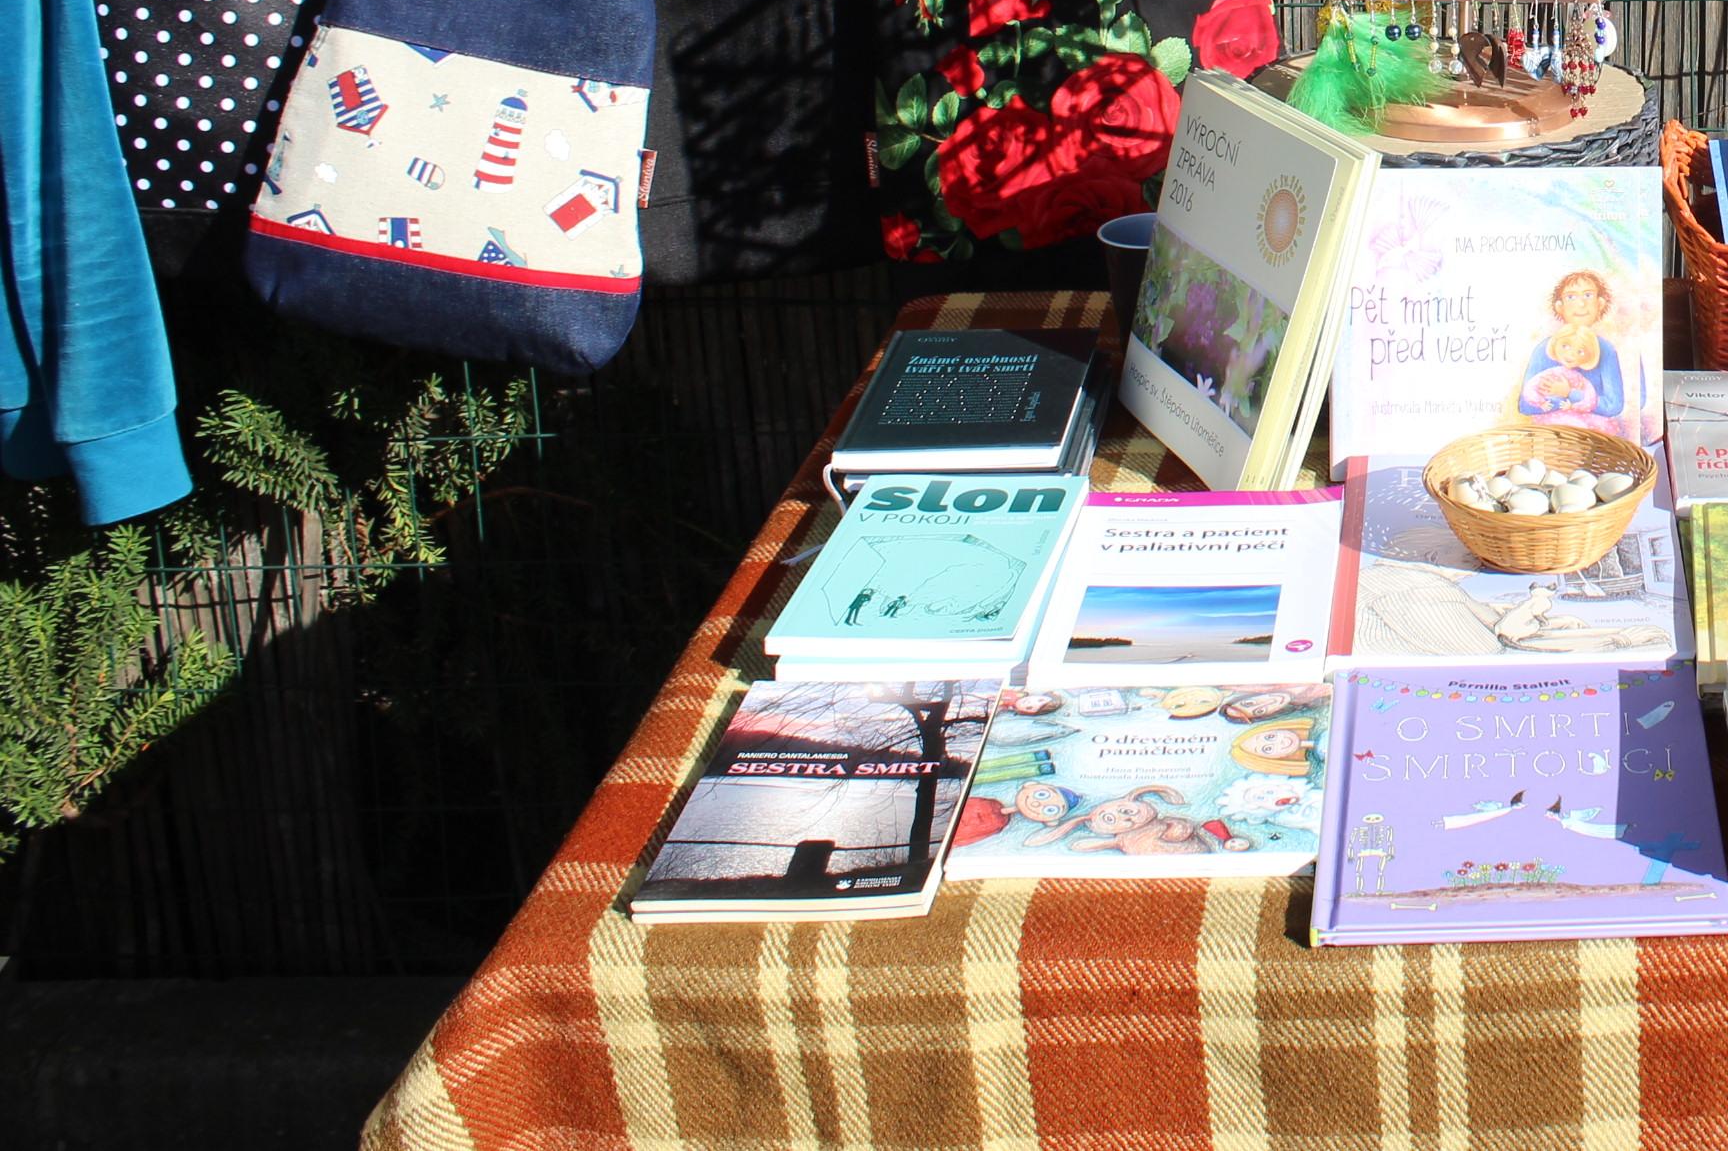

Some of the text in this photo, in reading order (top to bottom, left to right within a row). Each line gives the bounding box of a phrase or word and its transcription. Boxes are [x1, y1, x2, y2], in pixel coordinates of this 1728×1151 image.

[1186, 114, 1242, 167] VÝROČNÍ
[1176, 147, 1215, 192] ZPRÁVA
[1170, 179, 1194, 212] 2016
[1455, 236, 1474, 253] IVA
[1350, 285, 1475, 326] Pět minut
[908, 353, 1039, 365] Známé osobnosti
[1370, 324, 1513, 381] před večeří
[992, 363, 1035, 373] smrti
[1685, 391, 1726, 399] Viktor
[1695, 446, 1709, 456] A
[1697, 459, 1728, 470] říci
[862, 480, 1067, 513] slon
[859, 513, 875, 522] V
[881, 513, 970, 525] POKOJI
[1104, 528, 1175, 538] Sestra
[1202, 528, 1289, 539] pacient
[1101, 540, 1285, 553] v paliativní péči
[1447, 678, 1570, 691] Pernilla Stalfelt
[1397, 711, 1632, 742] O SMRTI
[1091, 732, 1219, 745] O dřevěném
[736, 751, 777, 759] RANIERO
[1098, 743, 1206, 759] panáčkovi
[727, 761, 940, 775] SESTRA SMRT
